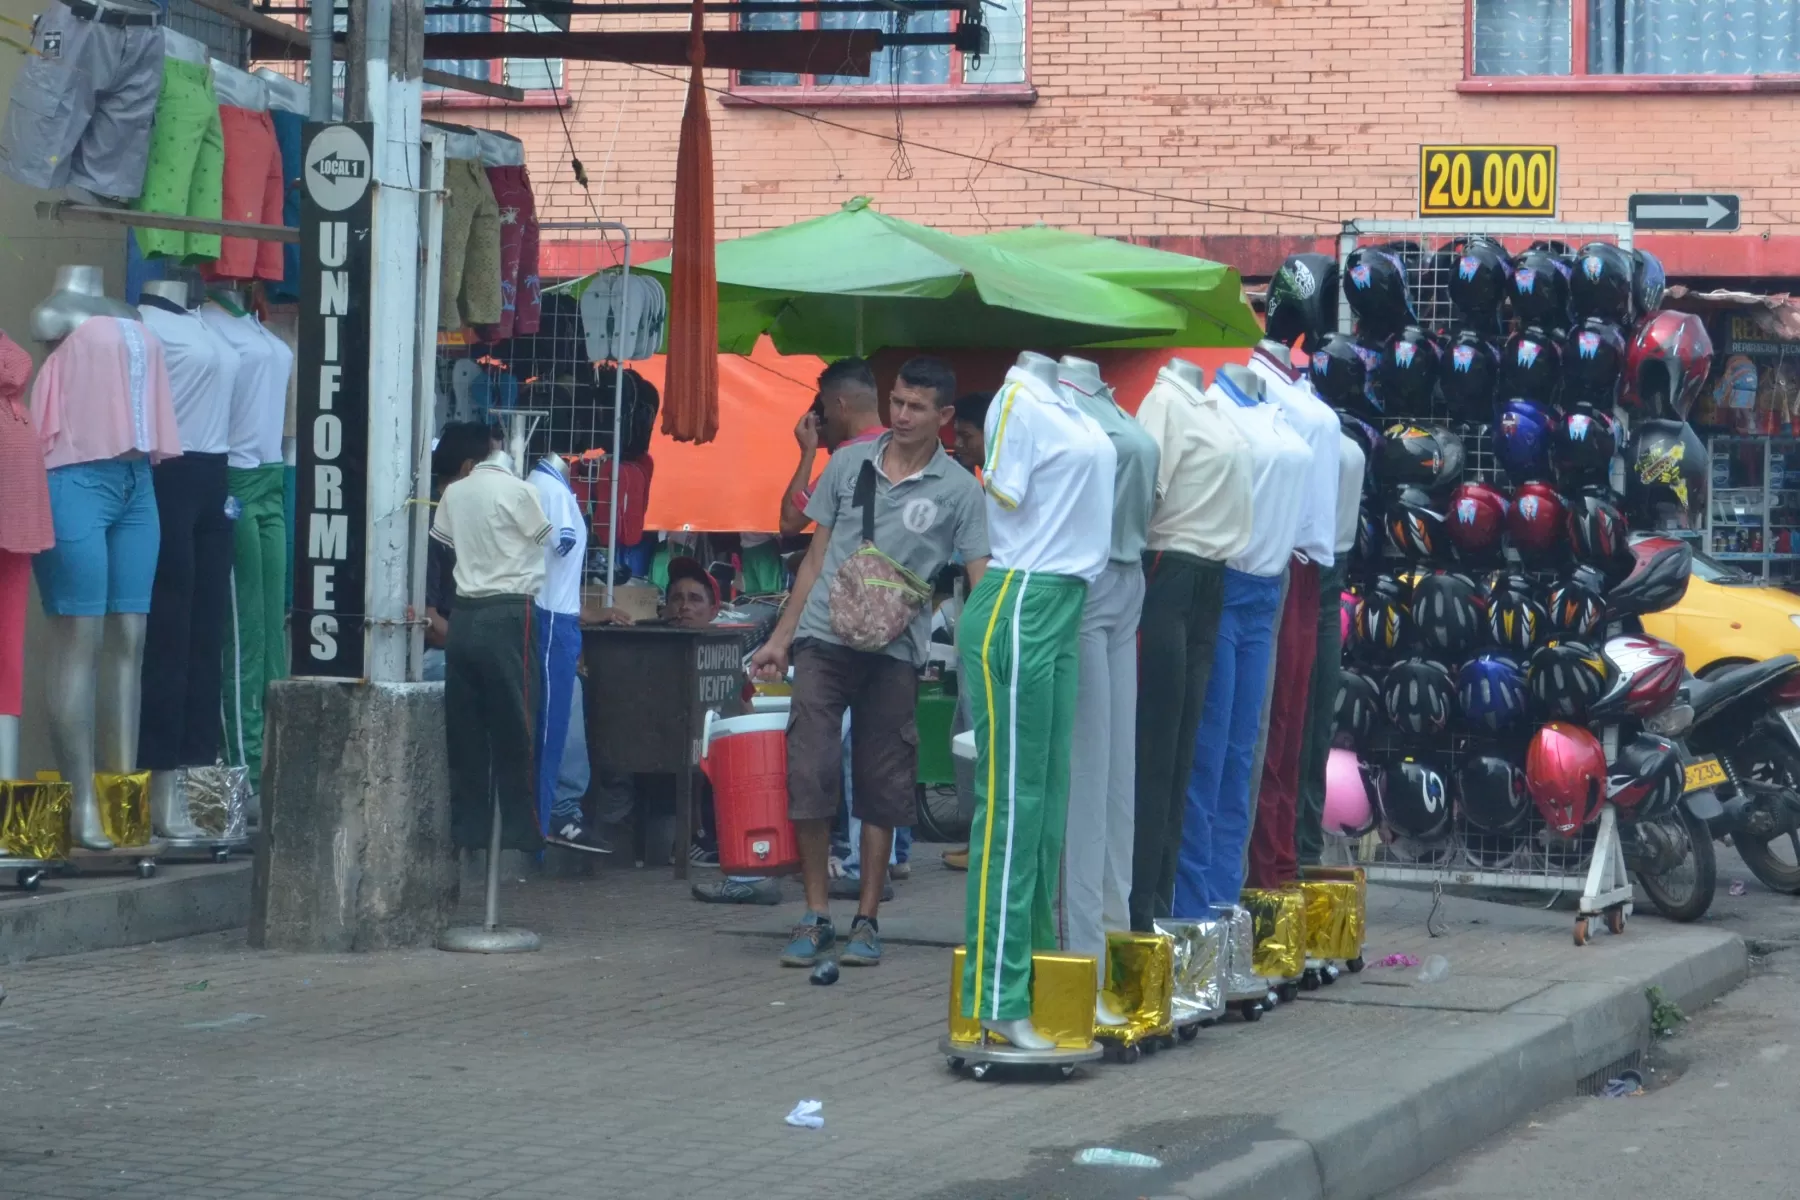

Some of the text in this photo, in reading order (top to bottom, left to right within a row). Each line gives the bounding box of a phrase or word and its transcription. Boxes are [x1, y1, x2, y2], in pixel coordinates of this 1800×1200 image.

[320, 160, 358, 176] LOCAL 1
[1428, 153, 1547, 207] 20.000
[308, 221, 348, 661] UNIFORMES
[697, 643, 739, 670] COMPRA
